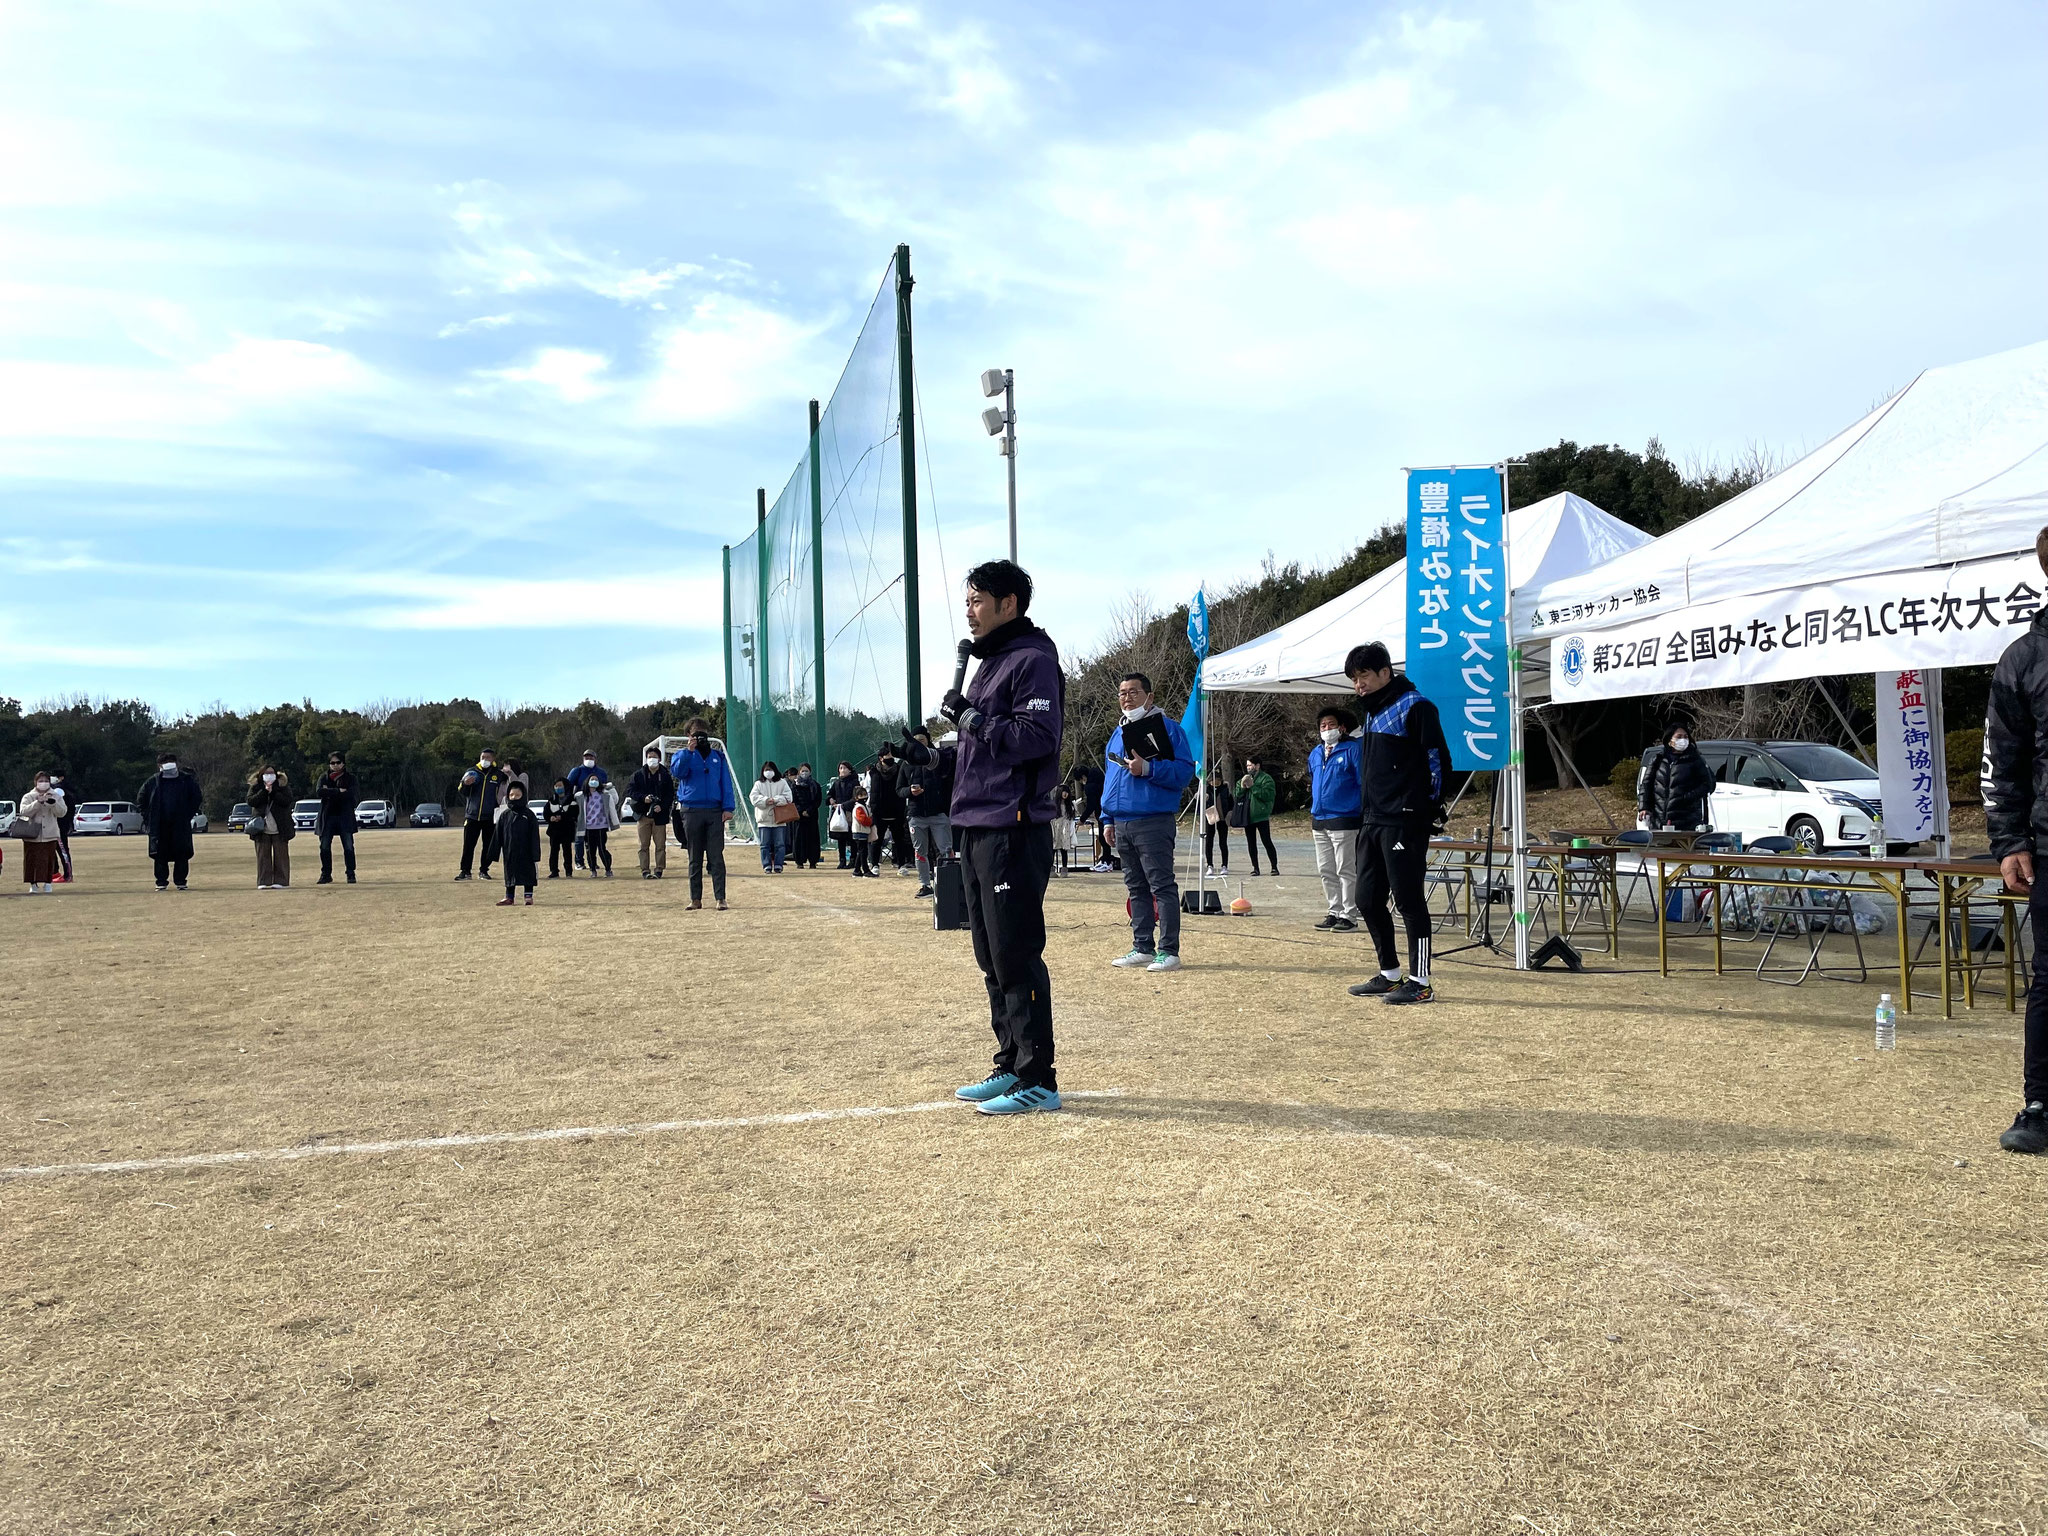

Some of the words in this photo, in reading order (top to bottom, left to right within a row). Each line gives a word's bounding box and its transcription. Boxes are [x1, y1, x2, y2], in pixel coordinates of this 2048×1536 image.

[1549, 583, 1661, 625] 東三河サッカー協会
[1593, 637, 1661, 674] 第52回
[1666, 581, 2048, 665] 全国みなと同名LC年次大会
[1570, 652, 1578, 670] L
